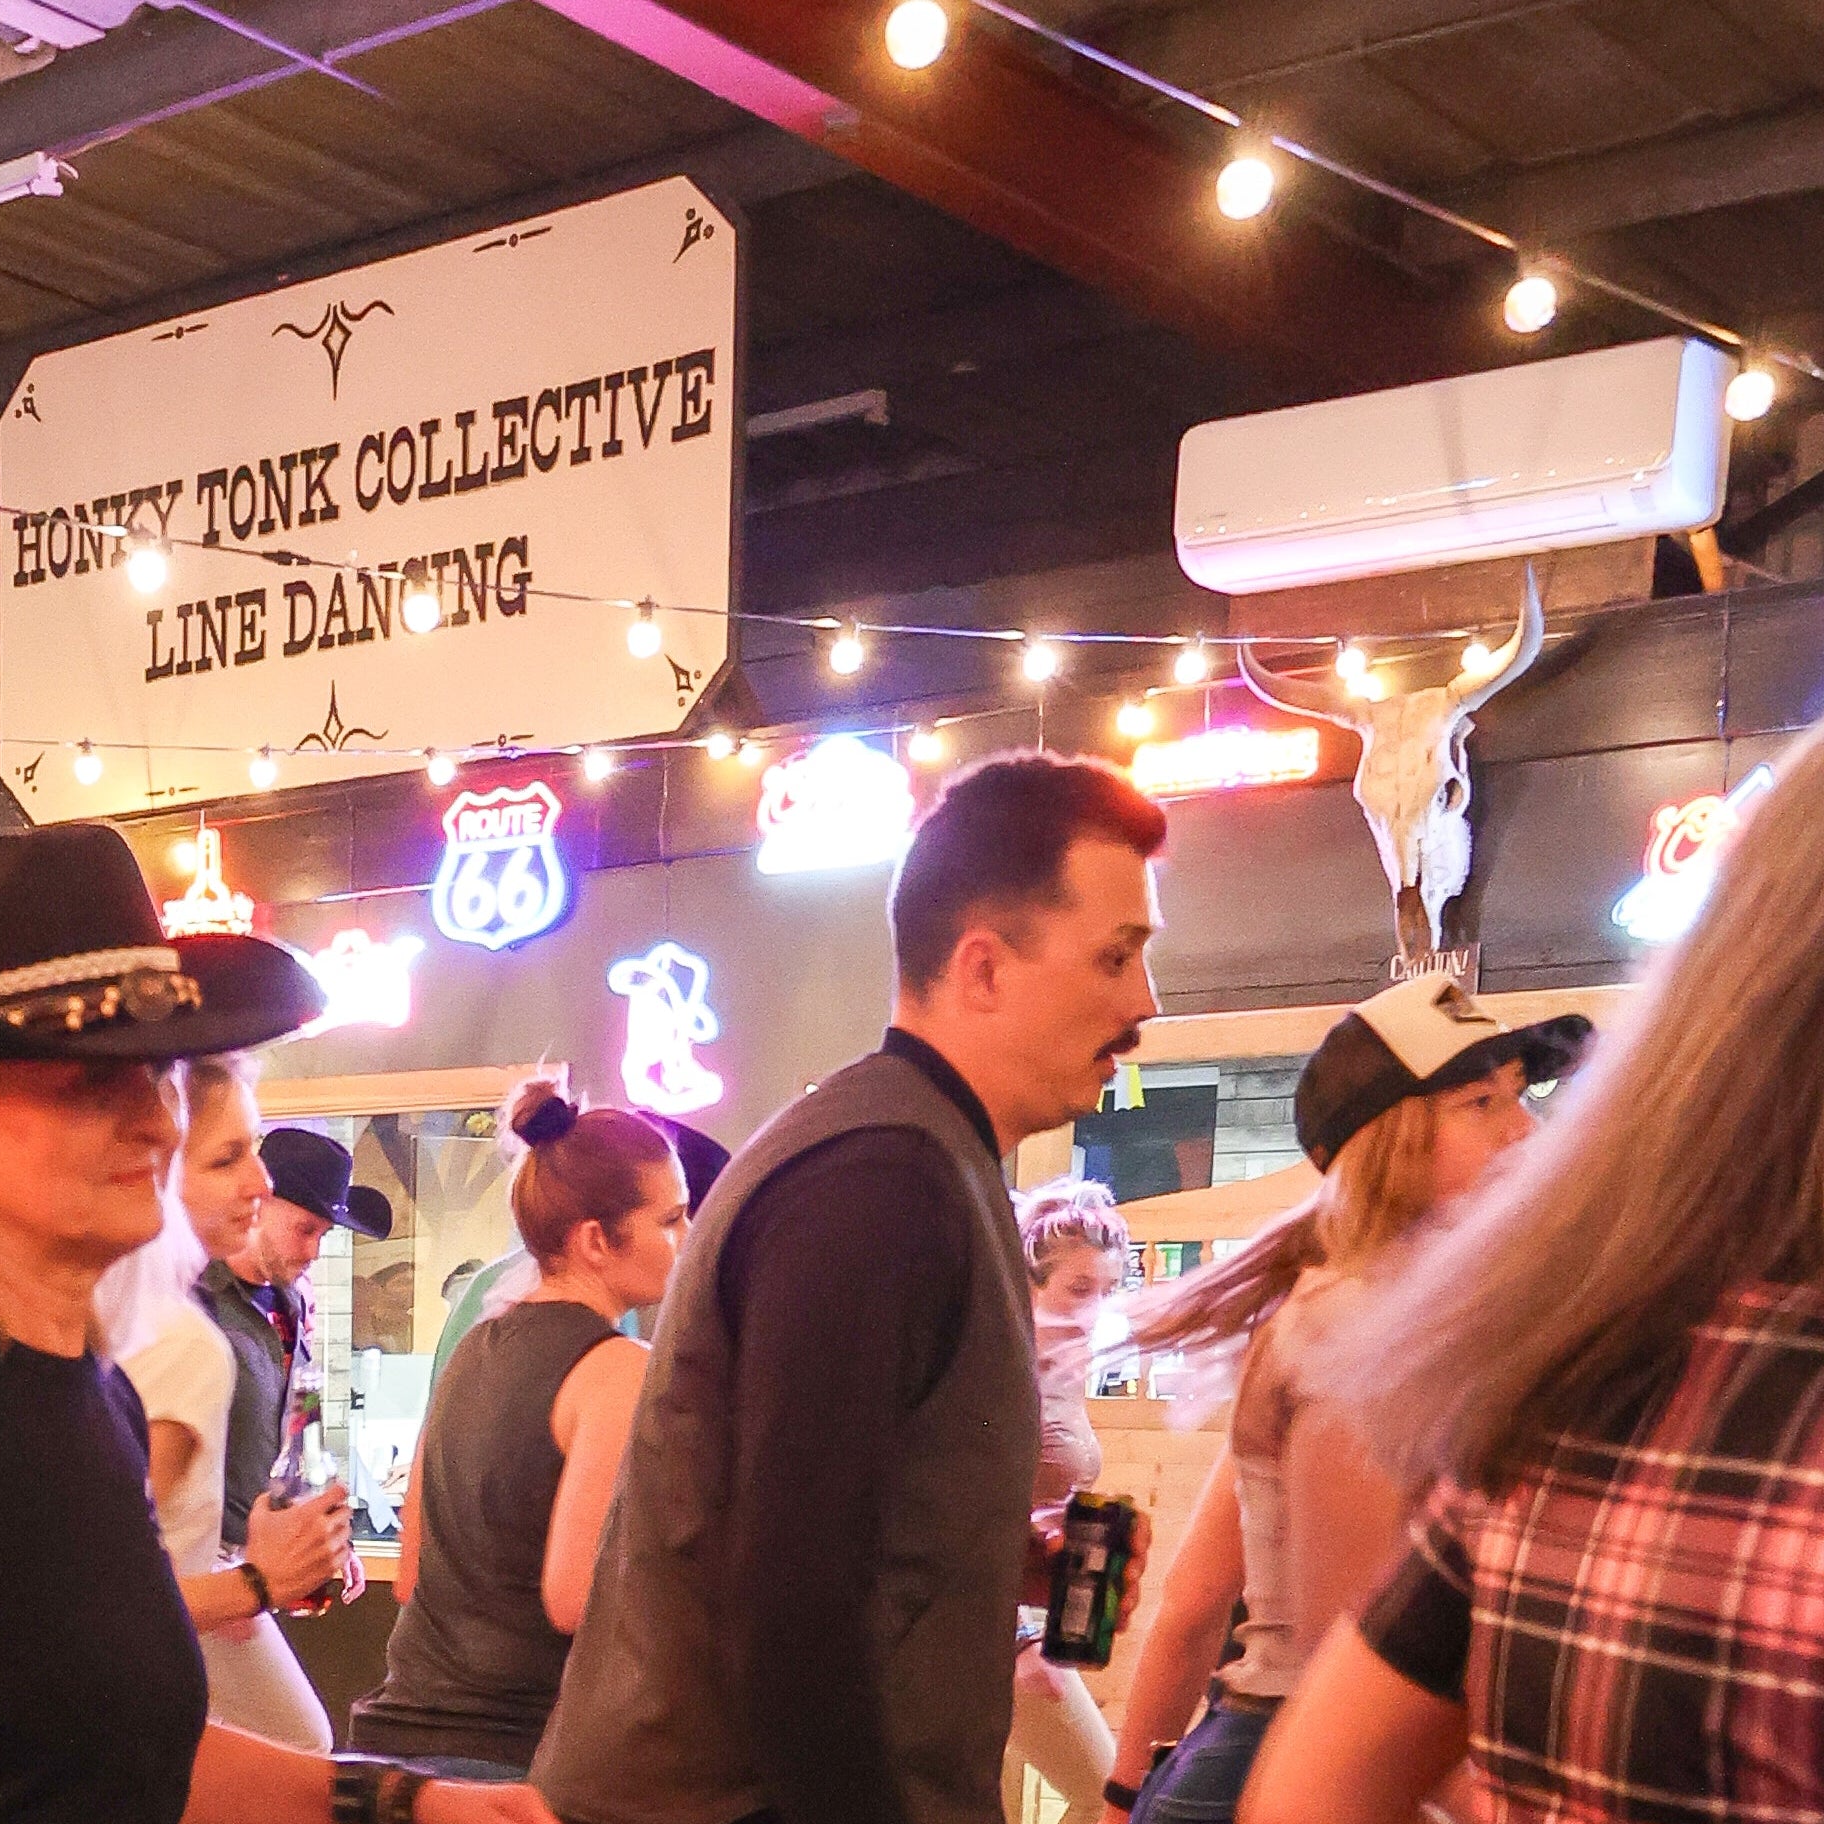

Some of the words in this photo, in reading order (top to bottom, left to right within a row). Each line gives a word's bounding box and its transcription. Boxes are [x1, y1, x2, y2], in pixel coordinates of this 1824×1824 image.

[13, 479, 183, 587] HONKY
[197, 442, 340, 548] TONK
[356, 347, 716, 512] COLLECTIVE
[145, 587, 266, 683] LINE
[458, 802, 543, 841] ROUTE
[451, 847, 544, 930] 66
